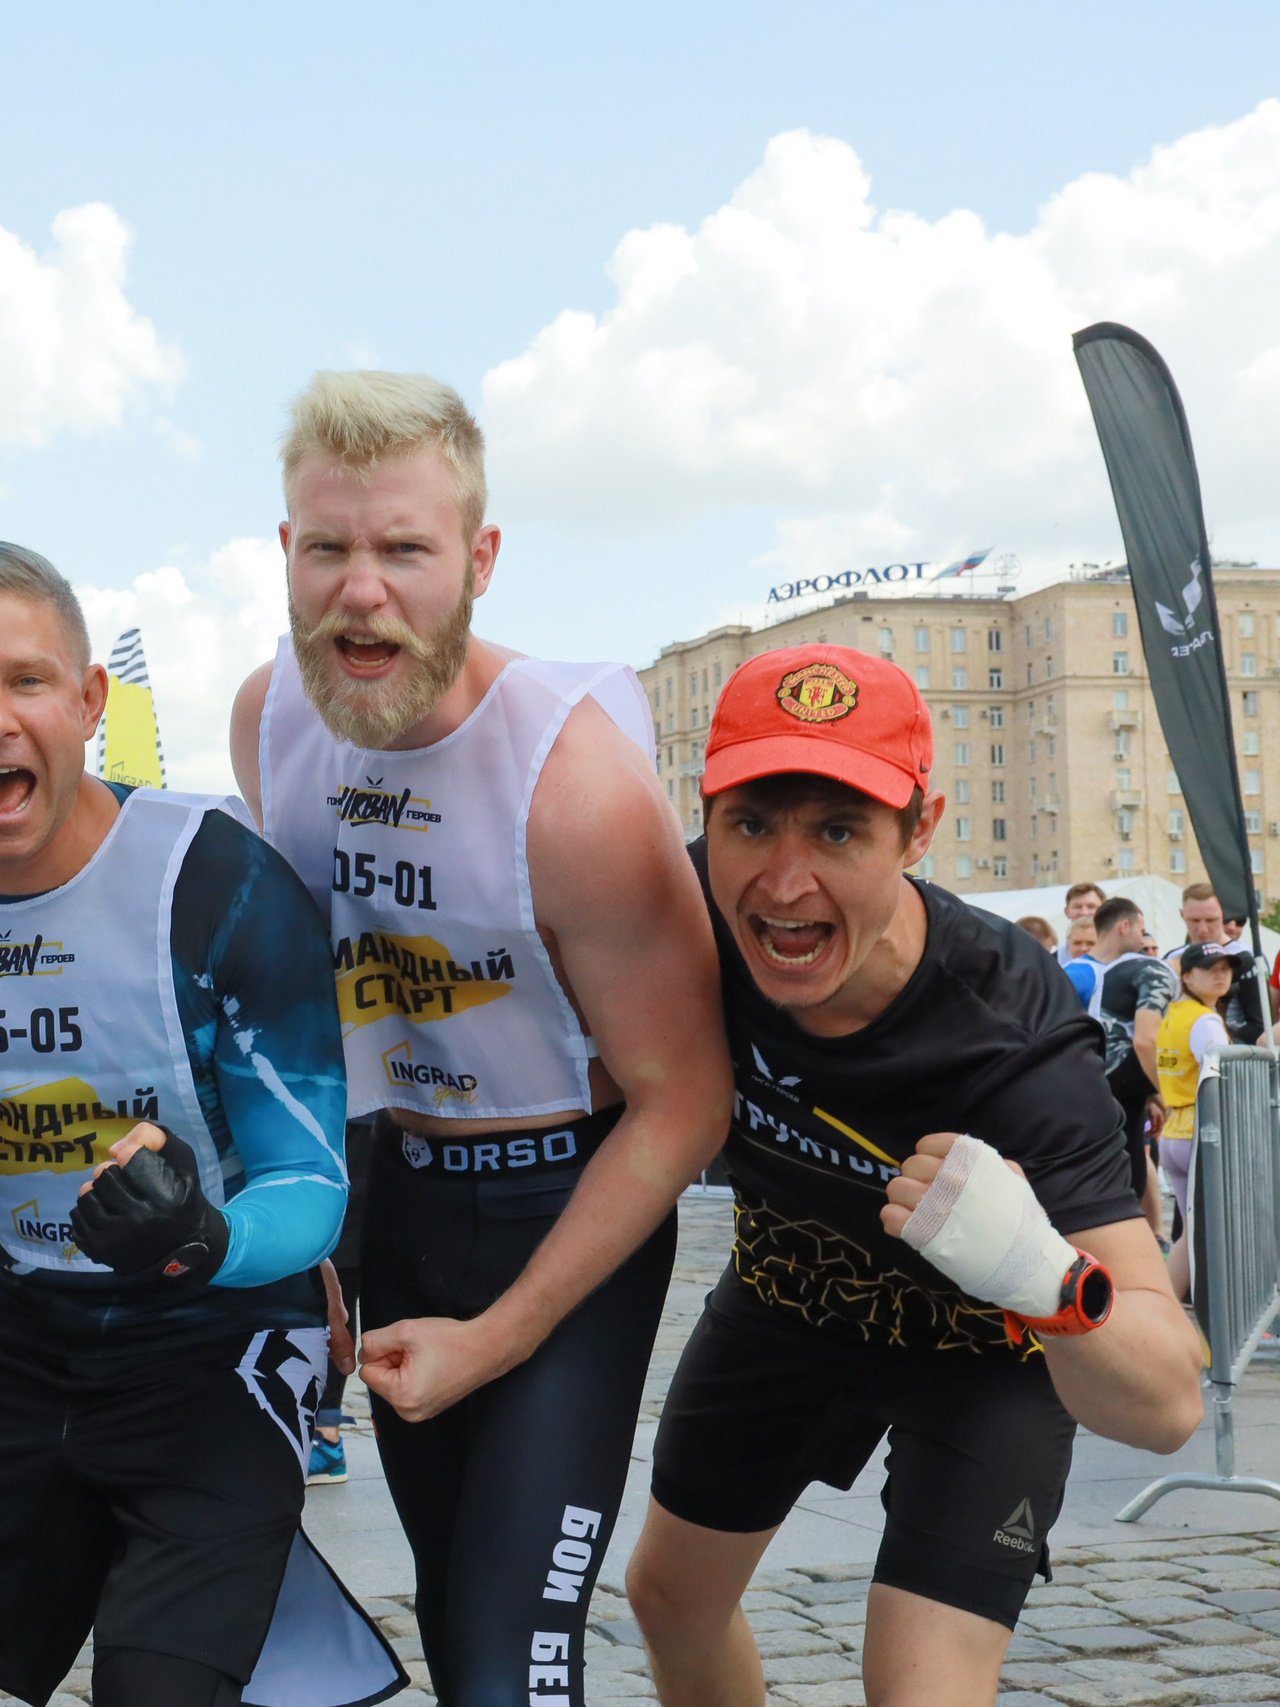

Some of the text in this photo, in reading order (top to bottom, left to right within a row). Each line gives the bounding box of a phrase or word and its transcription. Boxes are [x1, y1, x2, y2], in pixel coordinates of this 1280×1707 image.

[767, 562, 930, 603] АЭРОФЛОТ
[791, 703, 837, 718] UNITED
[406, 809, 442, 824] ГЕРОЕВ
[40, 953, 76, 964] ГЕРОЕВ
[355, 973, 457, 1015] СТАРТ
[390, 1061, 478, 1092] INGRAD
[432, 1077, 480, 1110] sport
[442, 1131, 577, 1172] ORSO
[542, 1504, 603, 1603] БОИ
[993, 1530, 1036, 1553] Reebok
